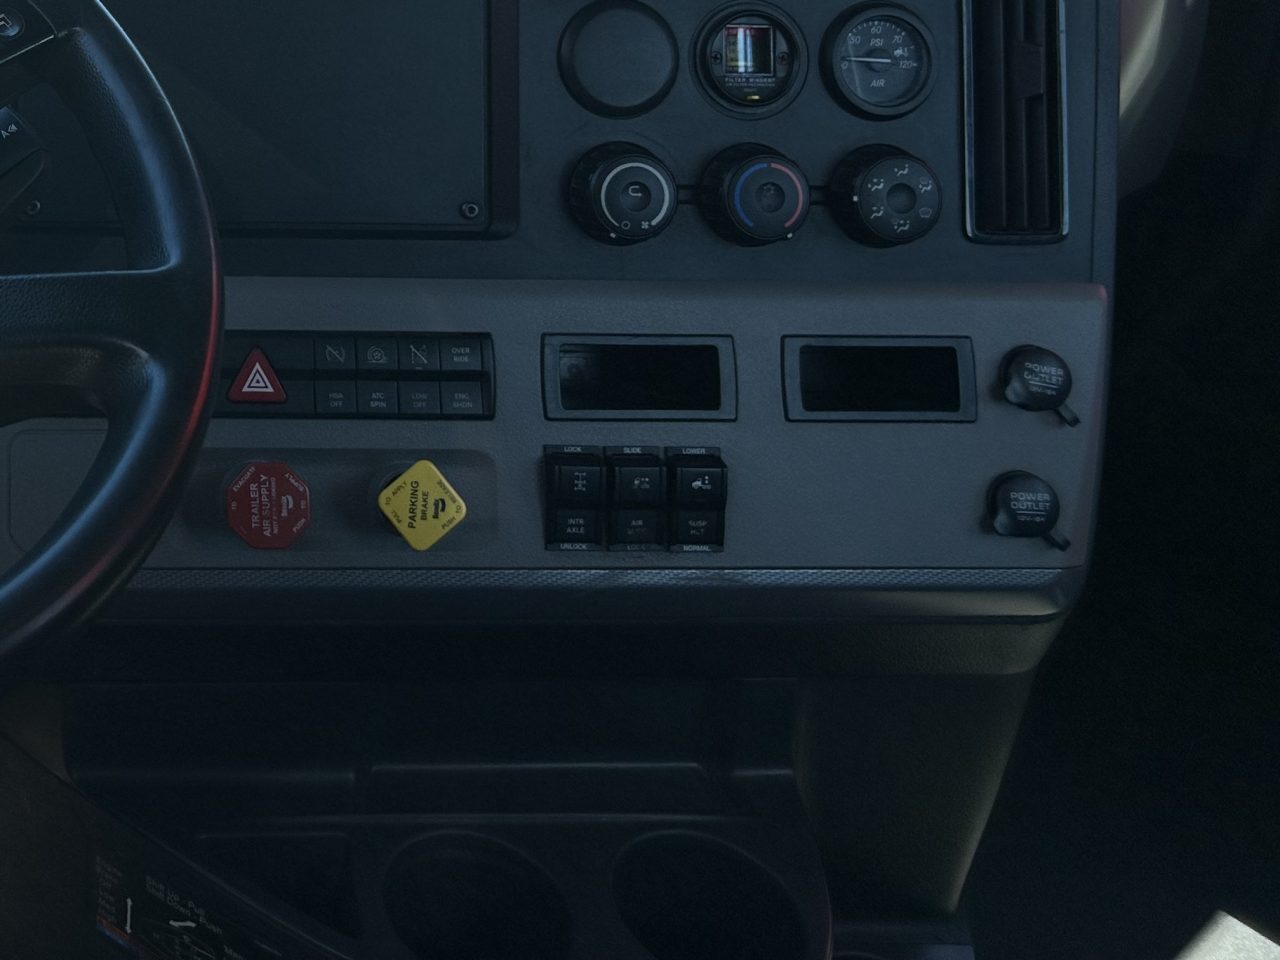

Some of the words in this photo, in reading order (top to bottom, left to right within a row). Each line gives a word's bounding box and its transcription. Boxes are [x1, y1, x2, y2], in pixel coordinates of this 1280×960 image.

[871, 26, 882, 34] 60
[870, 39, 884, 47] PSI
[892, 35, 903, 44] 70
[899, 61, 912, 69] 120
[870, 79, 885, 87] AIR
[1024, 362, 1064, 376] POWER
[1024, 371, 1064, 385] OUTLET
[260, 474, 270, 517] SUPPLY
[1010, 492, 1051, 501] POWER
[250, 483, 261, 529] TRAILER
[407, 480, 420, 529] PARKING
[420, 491, 429, 520] BRAKE
[1010, 501, 1051, 510] OUTLET
[456, 505, 462, 514] TO
[262, 519, 272, 537] AIR
